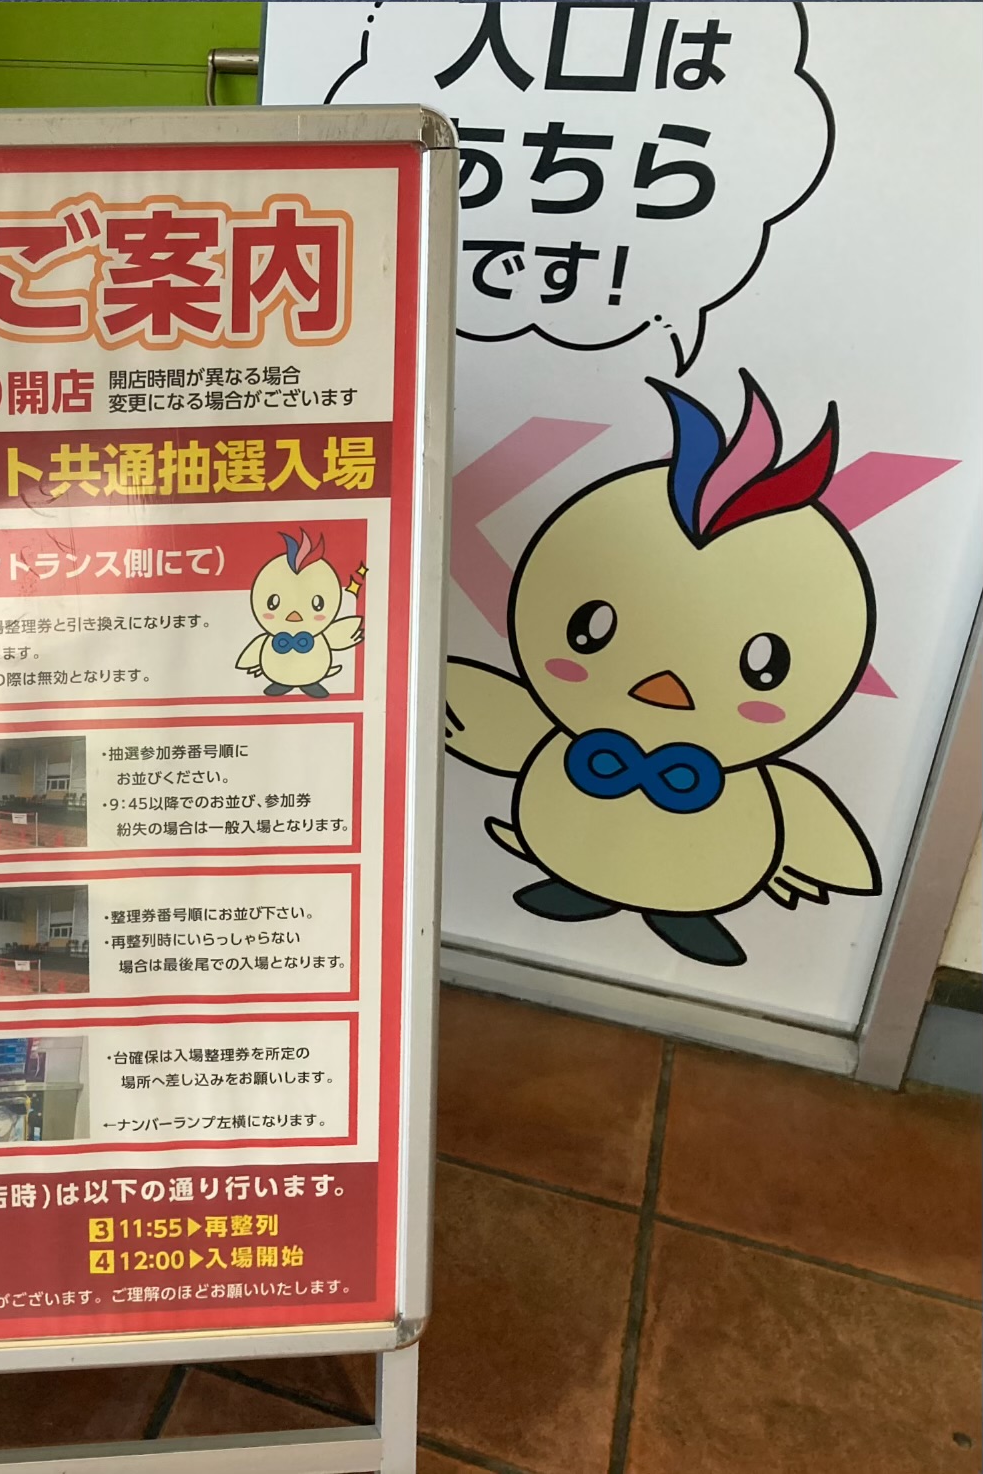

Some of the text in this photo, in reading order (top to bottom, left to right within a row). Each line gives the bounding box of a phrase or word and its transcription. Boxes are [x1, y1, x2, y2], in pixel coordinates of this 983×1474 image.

[433, 2, 732, 93] 入口は
[461, 238, 631, 307] です!
[107, 365, 302, 392] 開店時間が異なる場合
[107, 387, 359, 415] 変更になる場合がございます
[116, 770, 230, 786] お並びください。
[116, 818, 350, 838] 紛失の場合は一般入場となります。
[118, 955, 346, 974] 場合は最後尾での入場となります。
[119, 1069, 336, 1091] 場所へ差し込みをお願いします。
[118, 1217, 183, 1239] 11:55
[204, 1213, 279, 1239] 再整列
[119, 1250, 186, 1272] 12:00
[205, 1244, 305, 1271] 入場開始
